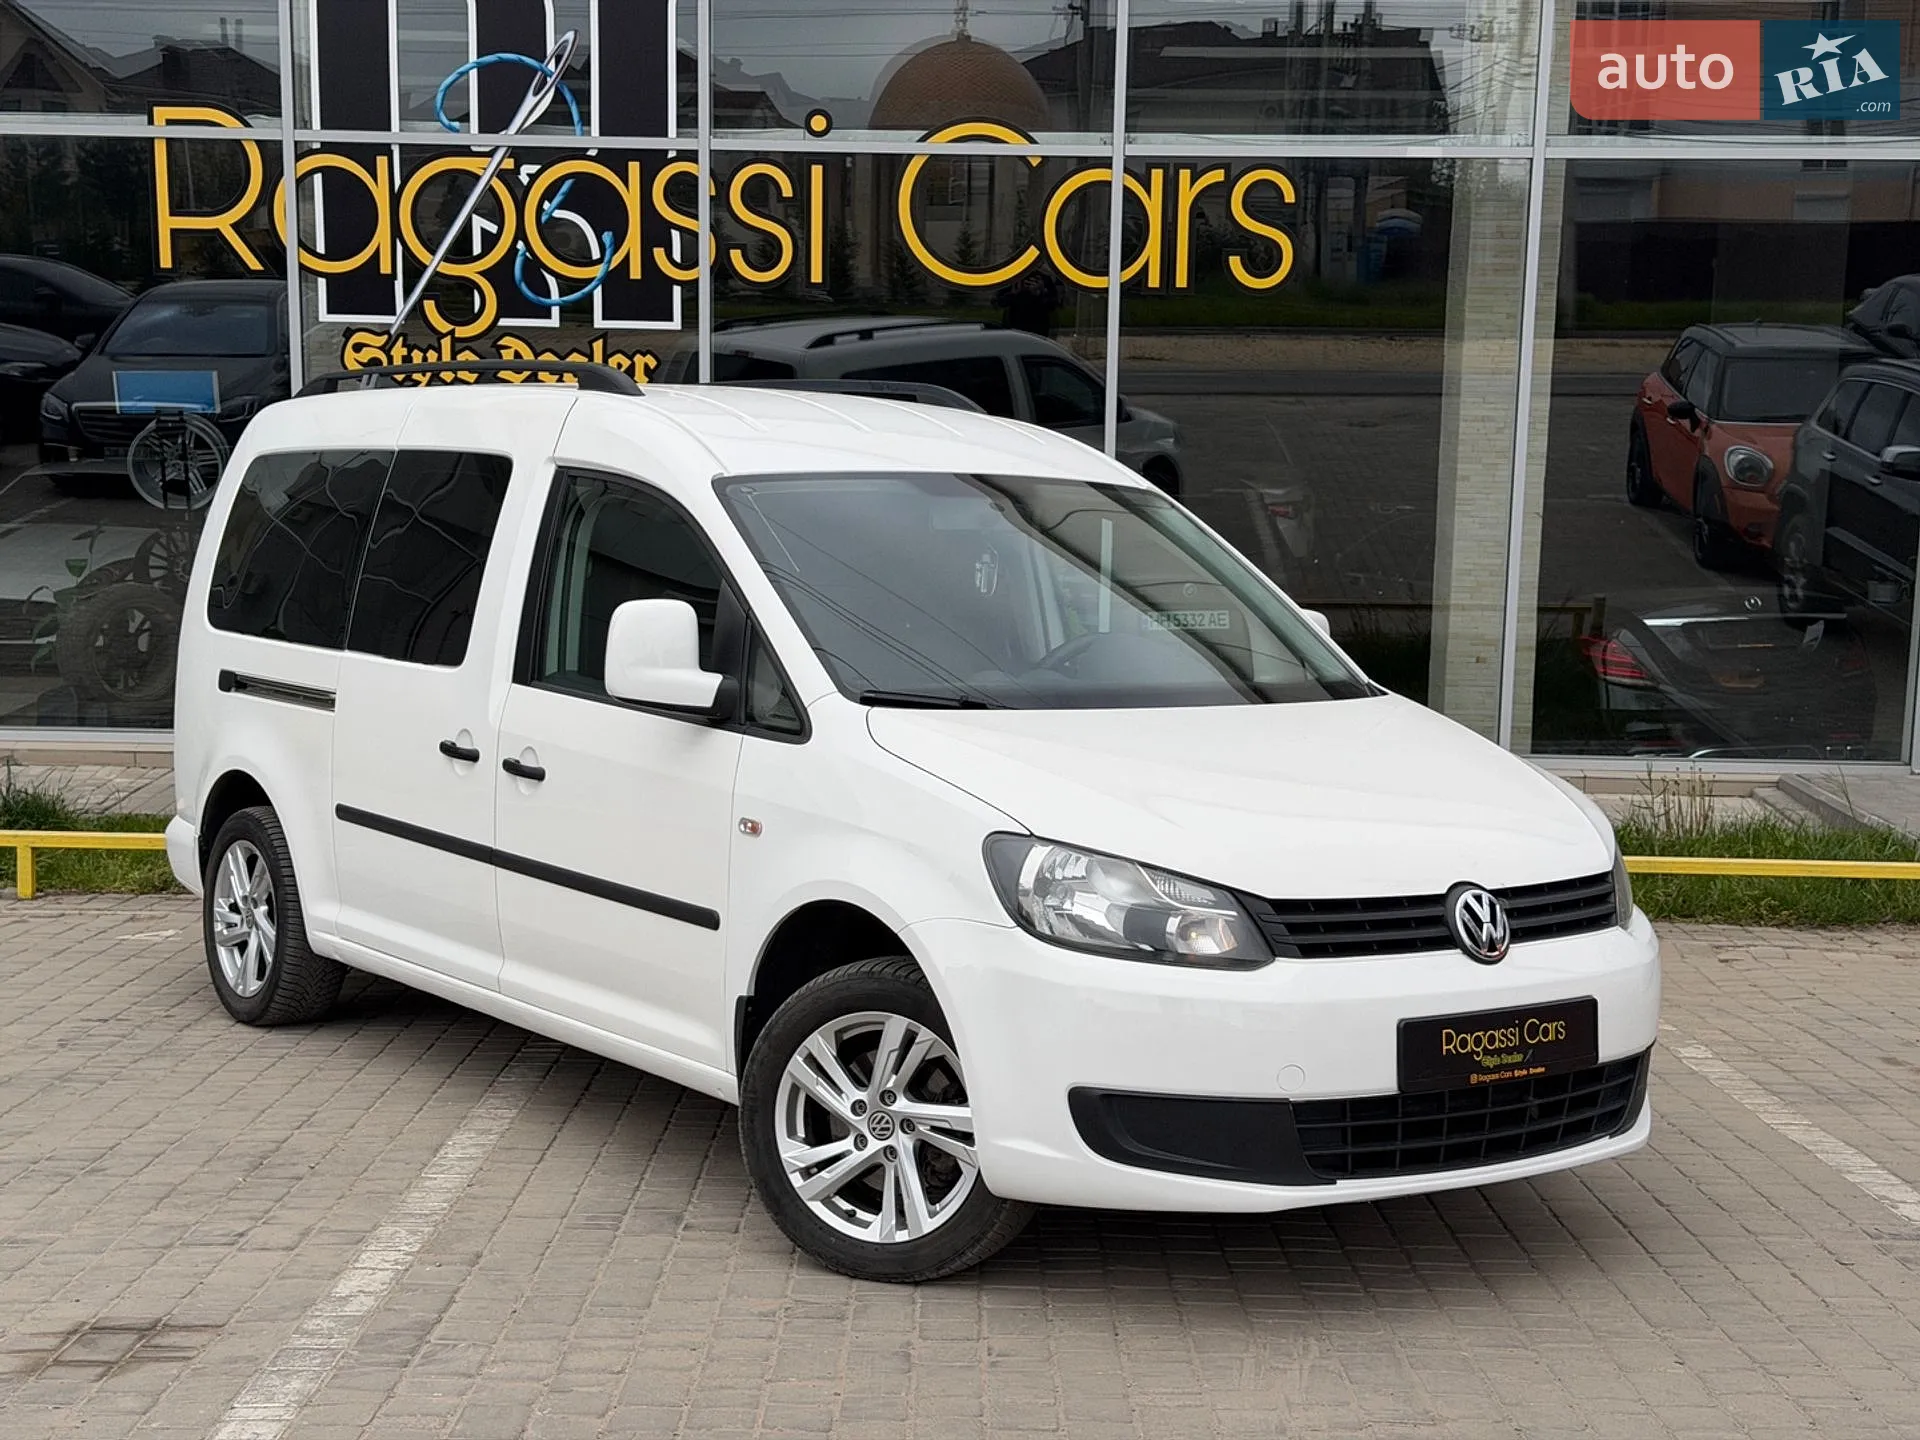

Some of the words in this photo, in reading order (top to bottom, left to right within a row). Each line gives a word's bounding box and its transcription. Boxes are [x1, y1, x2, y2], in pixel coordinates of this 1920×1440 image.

[153, 104, 826, 339] Ragassi
[897, 121, 1297, 290] Cars
[1173, 612, 1205, 628] 5332
[1208, 612, 1227, 627] AE
[1456, 889, 1509, 960] VW
[1442, 1020, 1519, 1061] Ragassi
[1524, 1018, 1566, 1044] Cars
